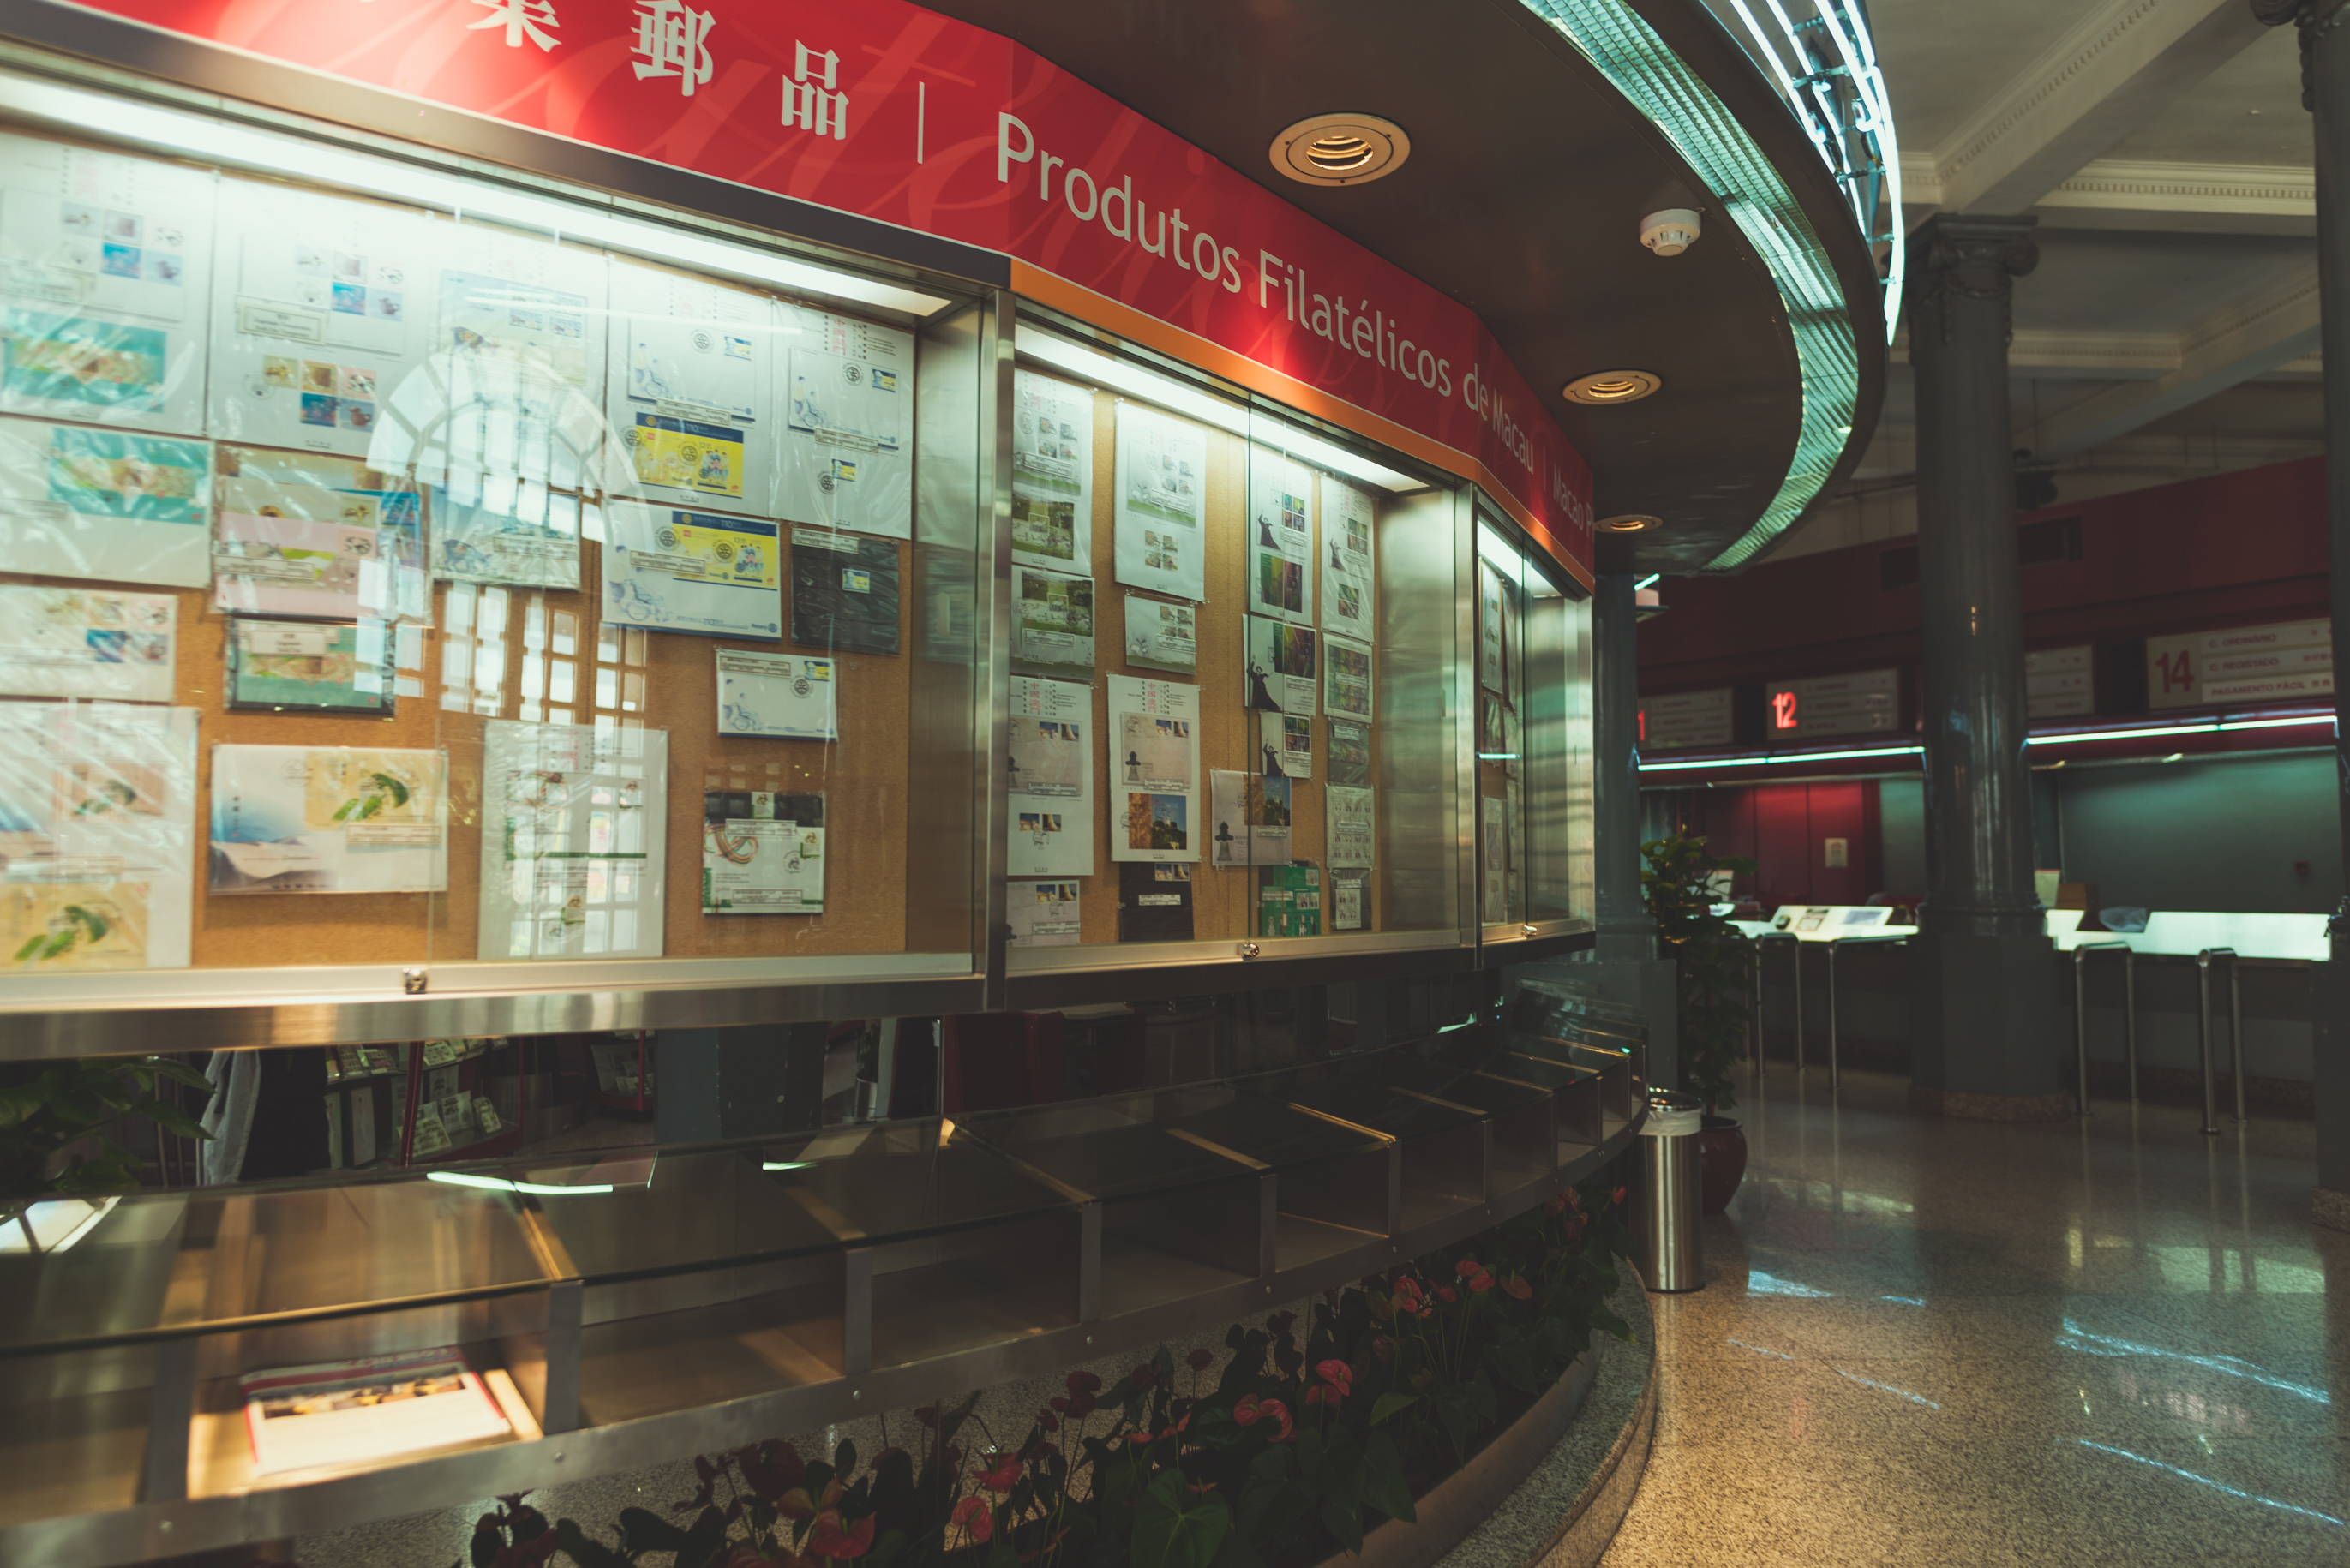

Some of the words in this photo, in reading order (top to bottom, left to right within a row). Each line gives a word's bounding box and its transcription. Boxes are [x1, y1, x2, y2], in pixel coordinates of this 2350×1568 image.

[998, 111, 1241, 293] Produtos
[1260, 248, 1452, 397] Filatélicos
[1463, 362, 1489, 422] de
[1492, 387, 1534, 475] Macau
[1553, 463, 1584, 531] Macao
[2155, 649, 2195, 694] 14
[2211, 684, 2274, 696] PAGAMENTO
[2276, 679, 2306, 691] FÁCIL
[1771, 691, 1797, 728] 12
